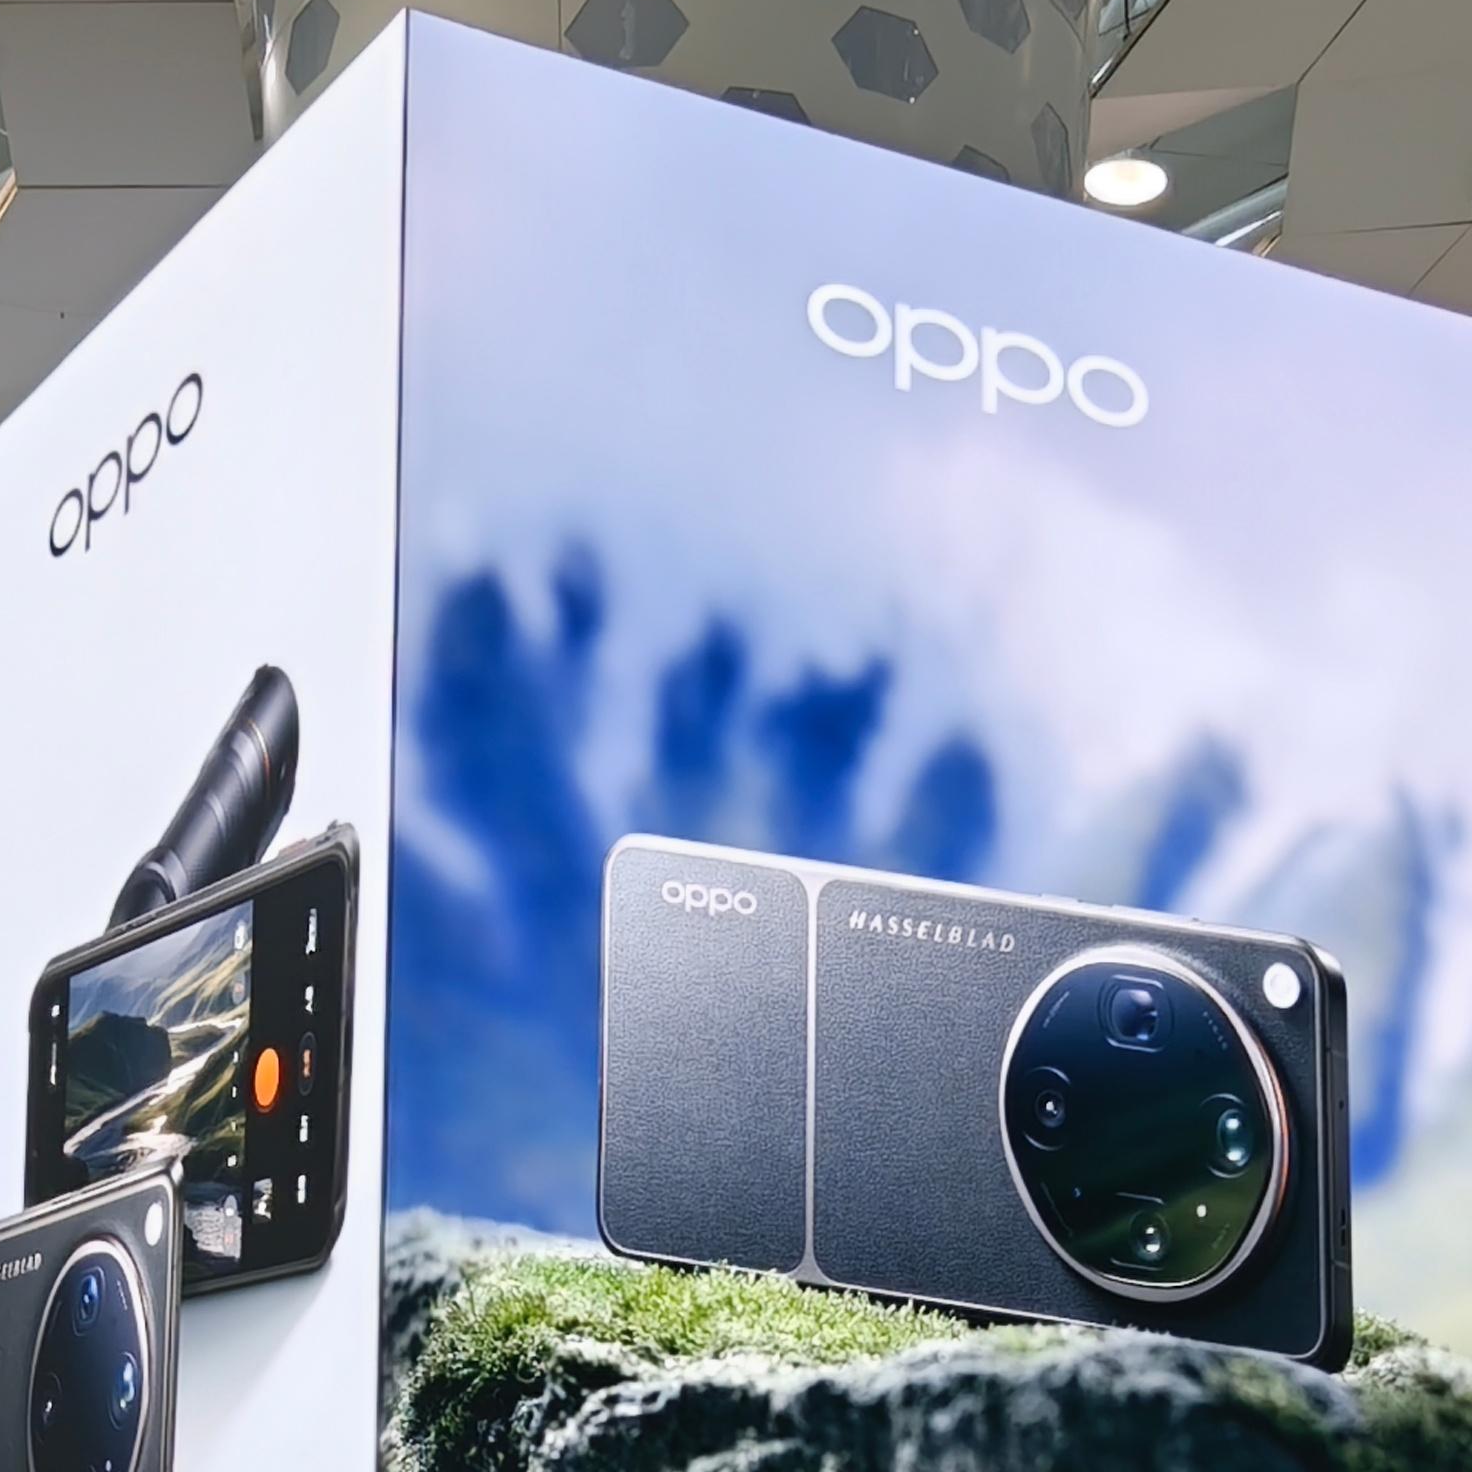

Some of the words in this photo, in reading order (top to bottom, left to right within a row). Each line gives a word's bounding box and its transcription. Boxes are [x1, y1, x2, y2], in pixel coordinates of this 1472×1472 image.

[806, 282, 1150, 428] oppo
[48, 368, 204, 558] oppo
[659, 878, 757, 919] oppo
[848, 908, 1018, 955] HASSELBLAD
